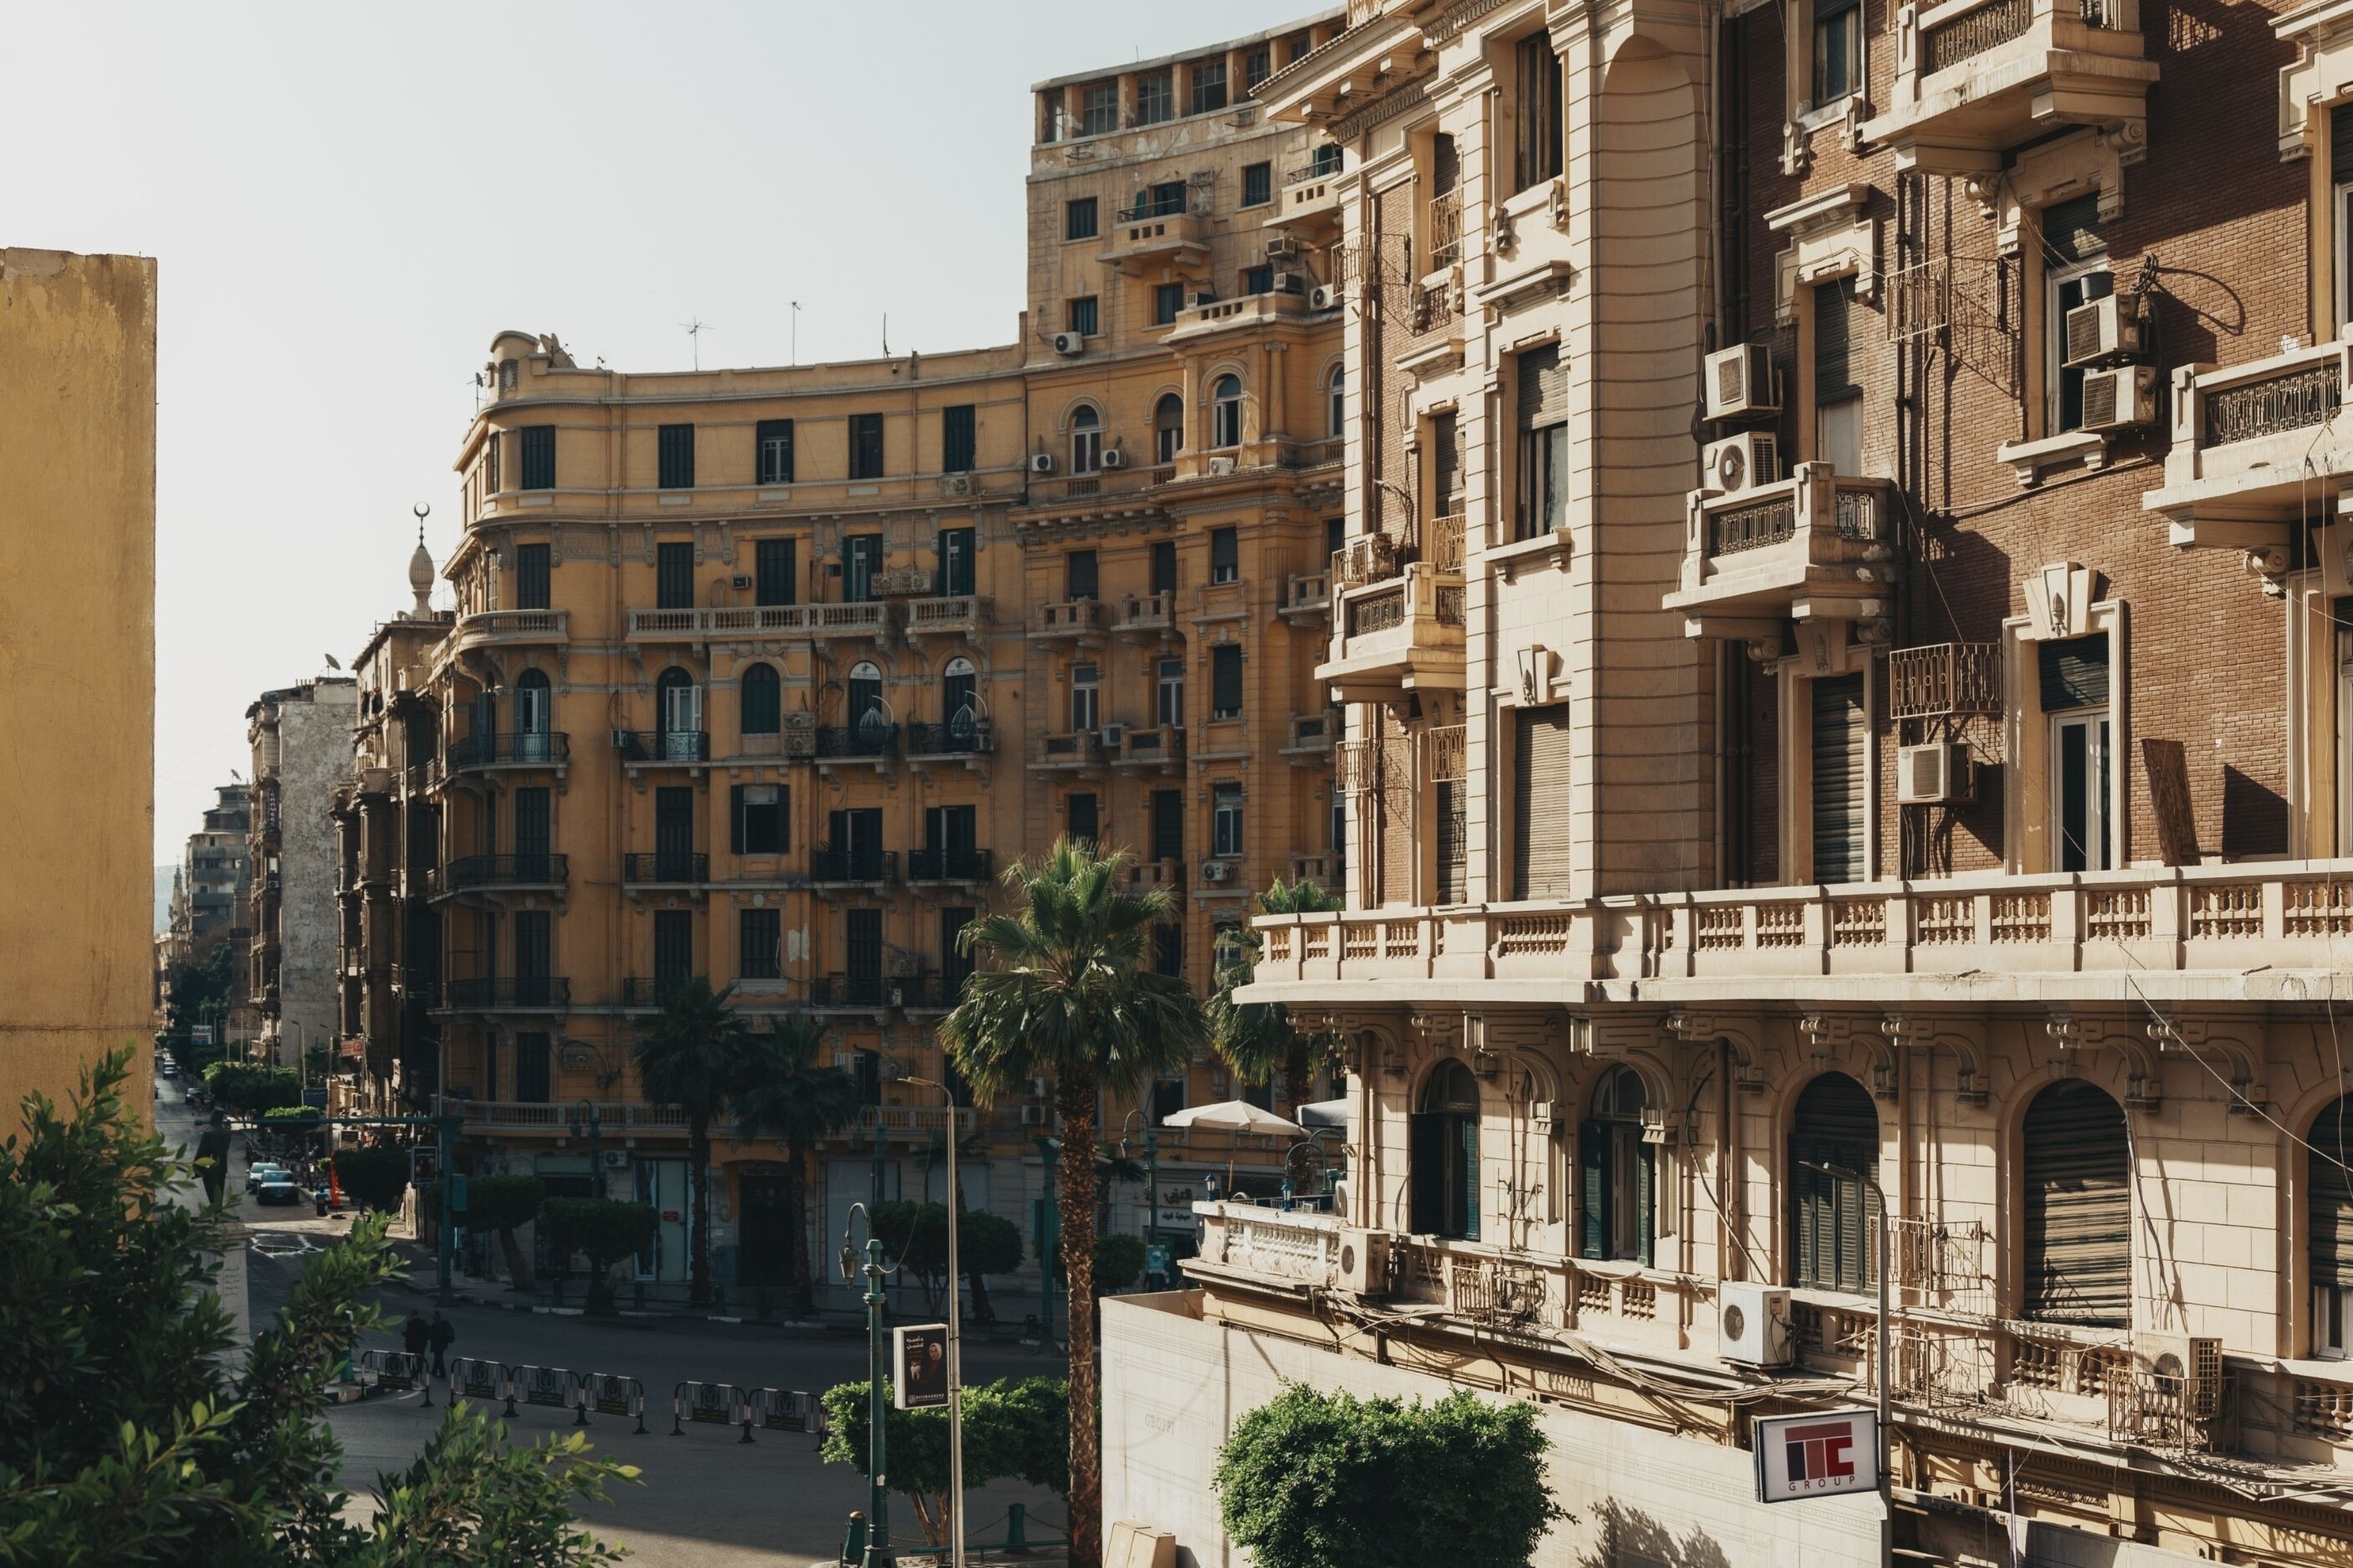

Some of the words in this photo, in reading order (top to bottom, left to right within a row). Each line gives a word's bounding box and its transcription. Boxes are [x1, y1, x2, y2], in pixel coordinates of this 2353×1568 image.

[1145, 1413, 1175, 1435] GROPPI
[1784, 1422, 1854, 1482] ITC
[1788, 1475, 1855, 1491] GROUP
